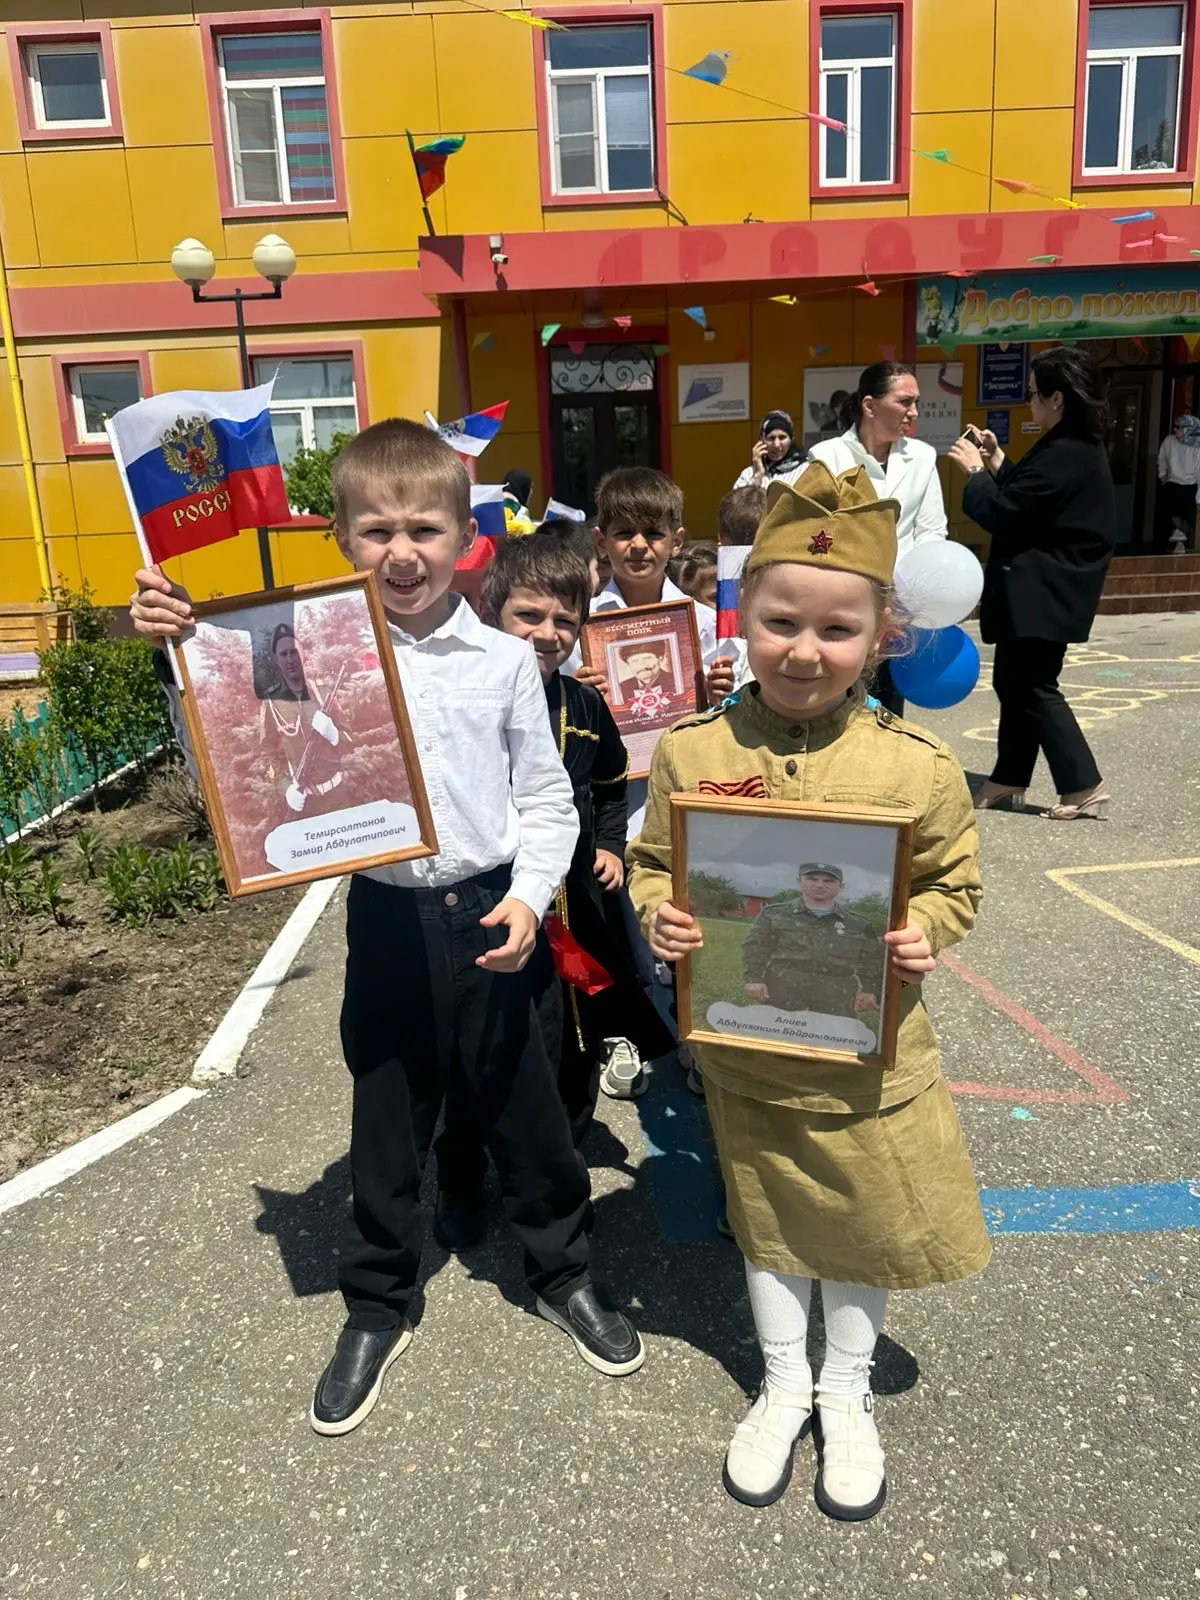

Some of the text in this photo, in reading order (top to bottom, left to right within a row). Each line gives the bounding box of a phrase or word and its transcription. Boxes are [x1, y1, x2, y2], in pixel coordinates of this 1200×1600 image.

[959, 287, 1200, 331] Добро пожал
[605, 616, 672, 633] БЕССМЕРТНЫЙ
[304, 815, 386, 842] Темирсолтанов
[290, 824, 406, 859] Замир Абдулатипович
[716, 1018, 780, 1034] Абдулхаким
[774, 1016, 808, 1027] Алиев
